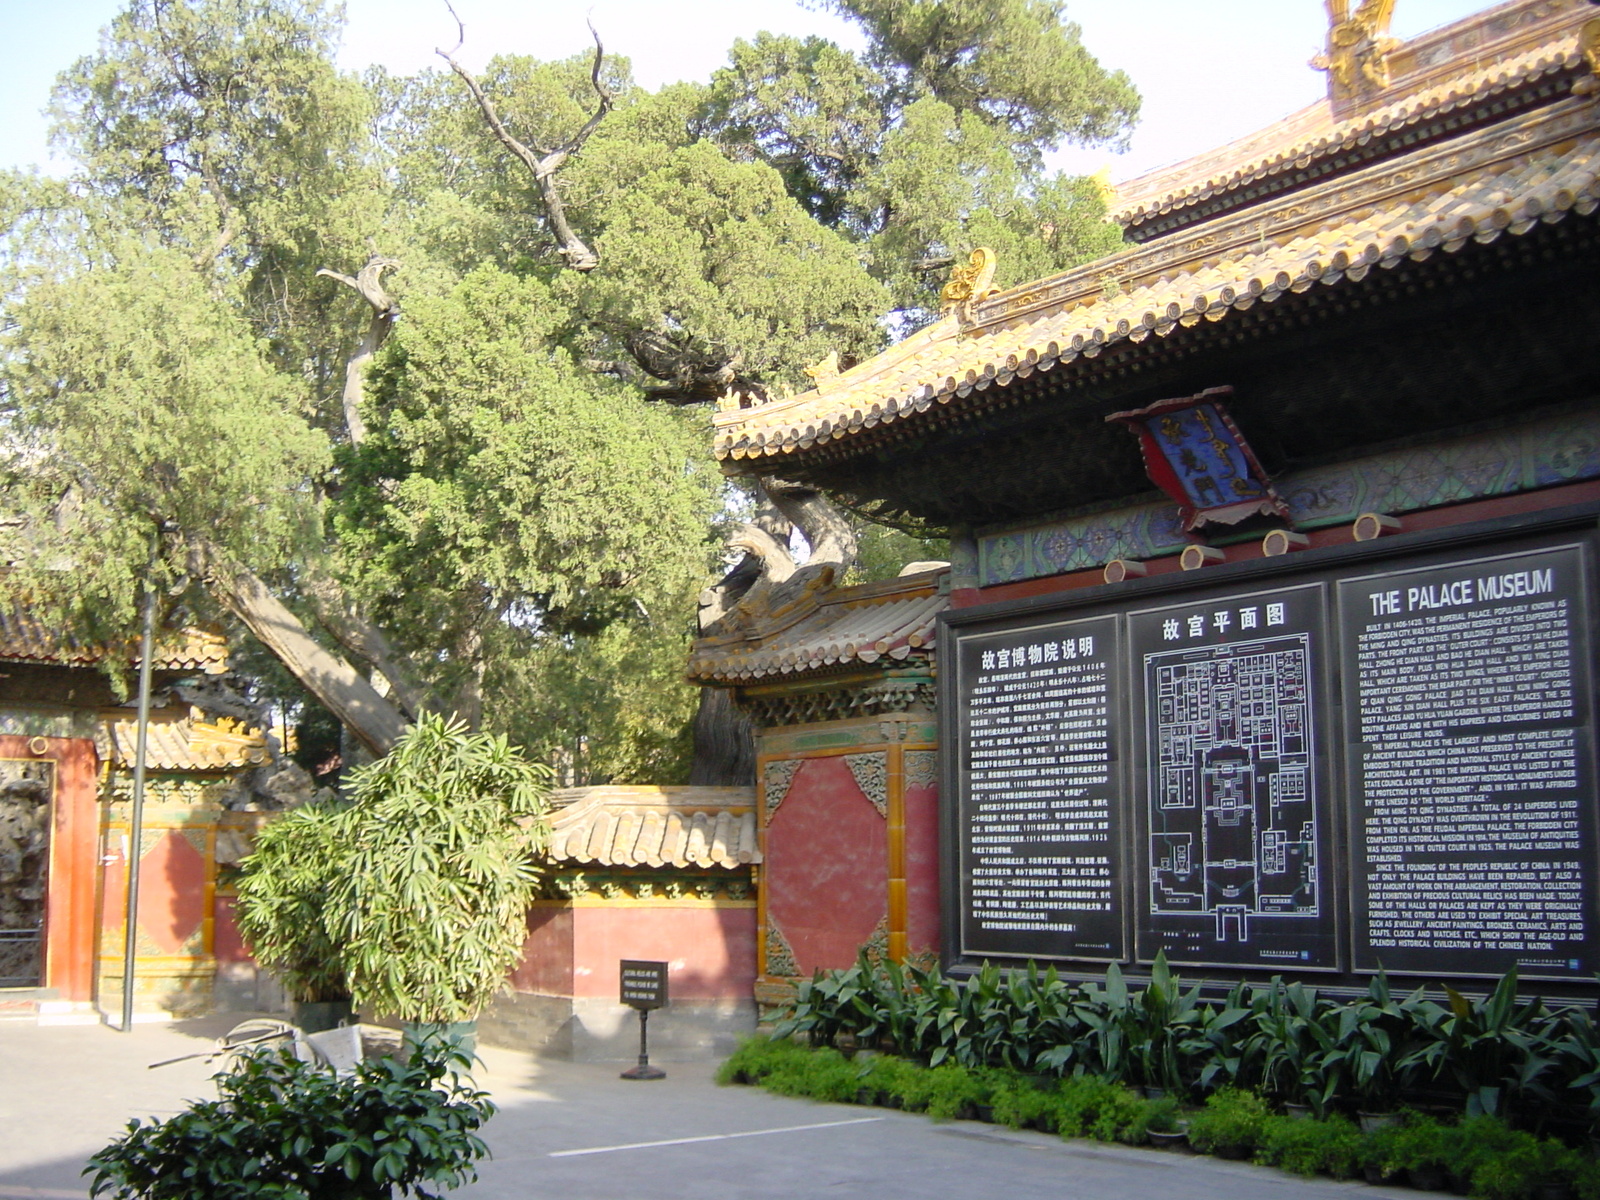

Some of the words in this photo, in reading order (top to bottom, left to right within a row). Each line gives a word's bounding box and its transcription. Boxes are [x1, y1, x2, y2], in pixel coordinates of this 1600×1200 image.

[1369, 590, 1401, 616] THE
[1408, 580, 1474, 611] PALACE
[1477, 568, 1553, 602] MUSEUM
[1162, 602, 1285, 641] 故宫平面图
[1365, 623, 1381, 632] BUILT
[1425, 616, 1436, 624] THE
[1438, 612, 1465, 622] IMPERIAL
[1493, 604, 1528, 616] POPULARLY
[981, 636, 1094, 670] 故宫博物院说明
[1415, 701, 1430, 709] DIAN
[1432, 699, 1447, 708] HALL
[1449, 698, 1464, 706] PLUS
[1466, 697, 1477, 705] THE
[1479, 696, 1490, 704] SIX
[1493, 694, 1510, 702] EAST
[1544, 689, 1557, 698] THE
[1559, 688, 1571, 697] SIX
[1383, 740, 1408, 749] IMPERIAL
[1410, 738, 1432, 747] PALACE
[1441, 737, 1452, 745] THE
[1453, 735, 1479, 744] LARGEST
[1482, 734, 1496, 742] AND
[1497, 732, 1515, 741] MOST
[1516, 730, 1549, 740] COMPLETE
[1551, 728, 1573, 737] GROUP
[1372, 751, 1395, 759] ANCIENT
[1396, 748, 1426, 758] BUILDINGS
[1426, 747, 1446, 756] WHICH
[1446, 746, 1465, 754] CHINA
[1466, 745, 1479, 753] HAS
[1479, 742, 1513, 752] PRESERVED
[1524, 741, 1536, 749] THE
[1363, 769, 1406, 778] ARCHITECTURAL
[1459, 764, 1486, 773] IMPERIAL
[1487, 762, 1511, 771] PALACE
[1512, 761, 1527, 770] WAS
[1528, 760, 1549, 769] LISTED
[1562, 758, 1575, 767] THE
[1434, 794, 1455, 803] WORLD
[1480, 802, 1499, 810] TOTAL
[1523, 800, 1557, 809] EMPERORS
[1558, 799, 1578, 807] LIVED
[1433, 823, 1455, 832] FEUDAL
[1457, 822, 1484, 831] IMPERIAL
[1514, 821, 1526, 829] THE
[1562, 819, 1578, 828] CITY
[1508, 841, 1532, 849] PALACE
[1534, 840, 1562, 848] MUSEUM
[1564, 840, 1579, 848] WAS
[1489, 861, 1517, 869] REPUBLIC
[1398, 939, 1430, 947] HISTORICAL
[1432, 940, 1471, 948] CIVILIZATION
[1498, 941, 1524, 949] CHINESE
[1568, 932, 1584, 940] AND
